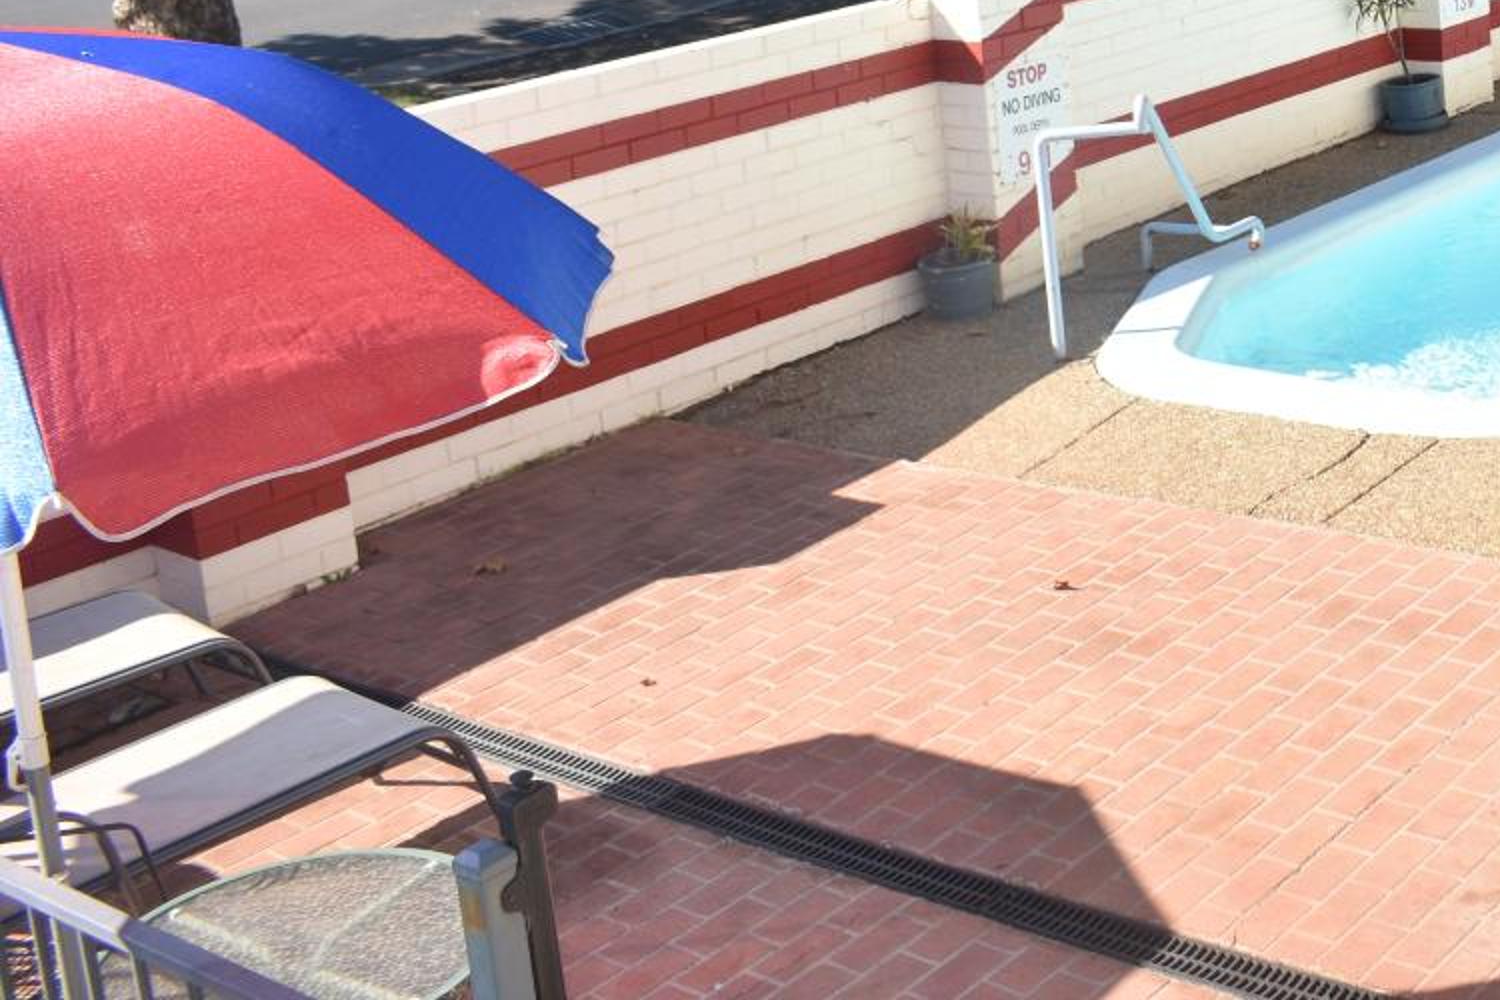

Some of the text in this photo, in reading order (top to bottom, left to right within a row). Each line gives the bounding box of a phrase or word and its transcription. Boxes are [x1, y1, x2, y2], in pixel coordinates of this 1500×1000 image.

[1006, 63, 1047, 89] STOP
[1001, 87, 1061, 116] NO DIVING
